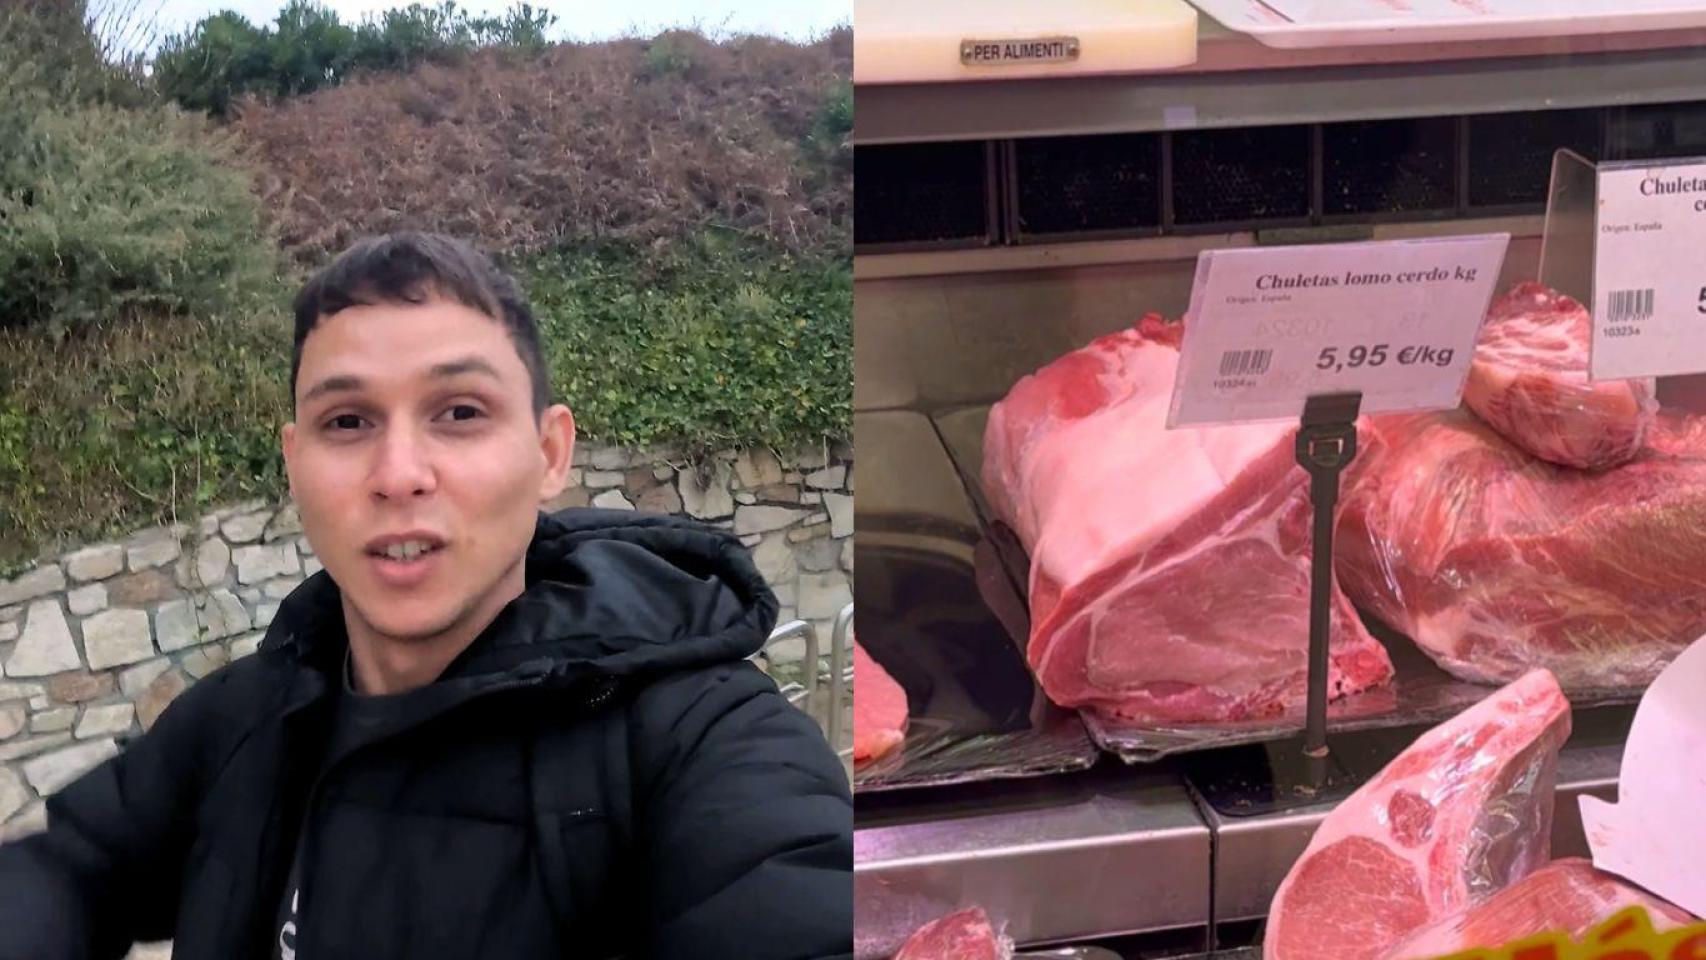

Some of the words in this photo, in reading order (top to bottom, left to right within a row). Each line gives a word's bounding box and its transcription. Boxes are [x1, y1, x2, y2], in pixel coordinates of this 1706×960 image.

[974, 44, 1000, 60] PER
[1004, 42, 1063, 59] ALIMENTI
[1256, 273, 1339, 290] Chuletas
[1344, 271, 1392, 285] lomo
[1396, 267, 1449, 283] cerdo
[1454, 265, 1477, 283] kg
[1316, 344, 1389, 373] 5,95
[1397, 345, 1454, 367] €/kg
